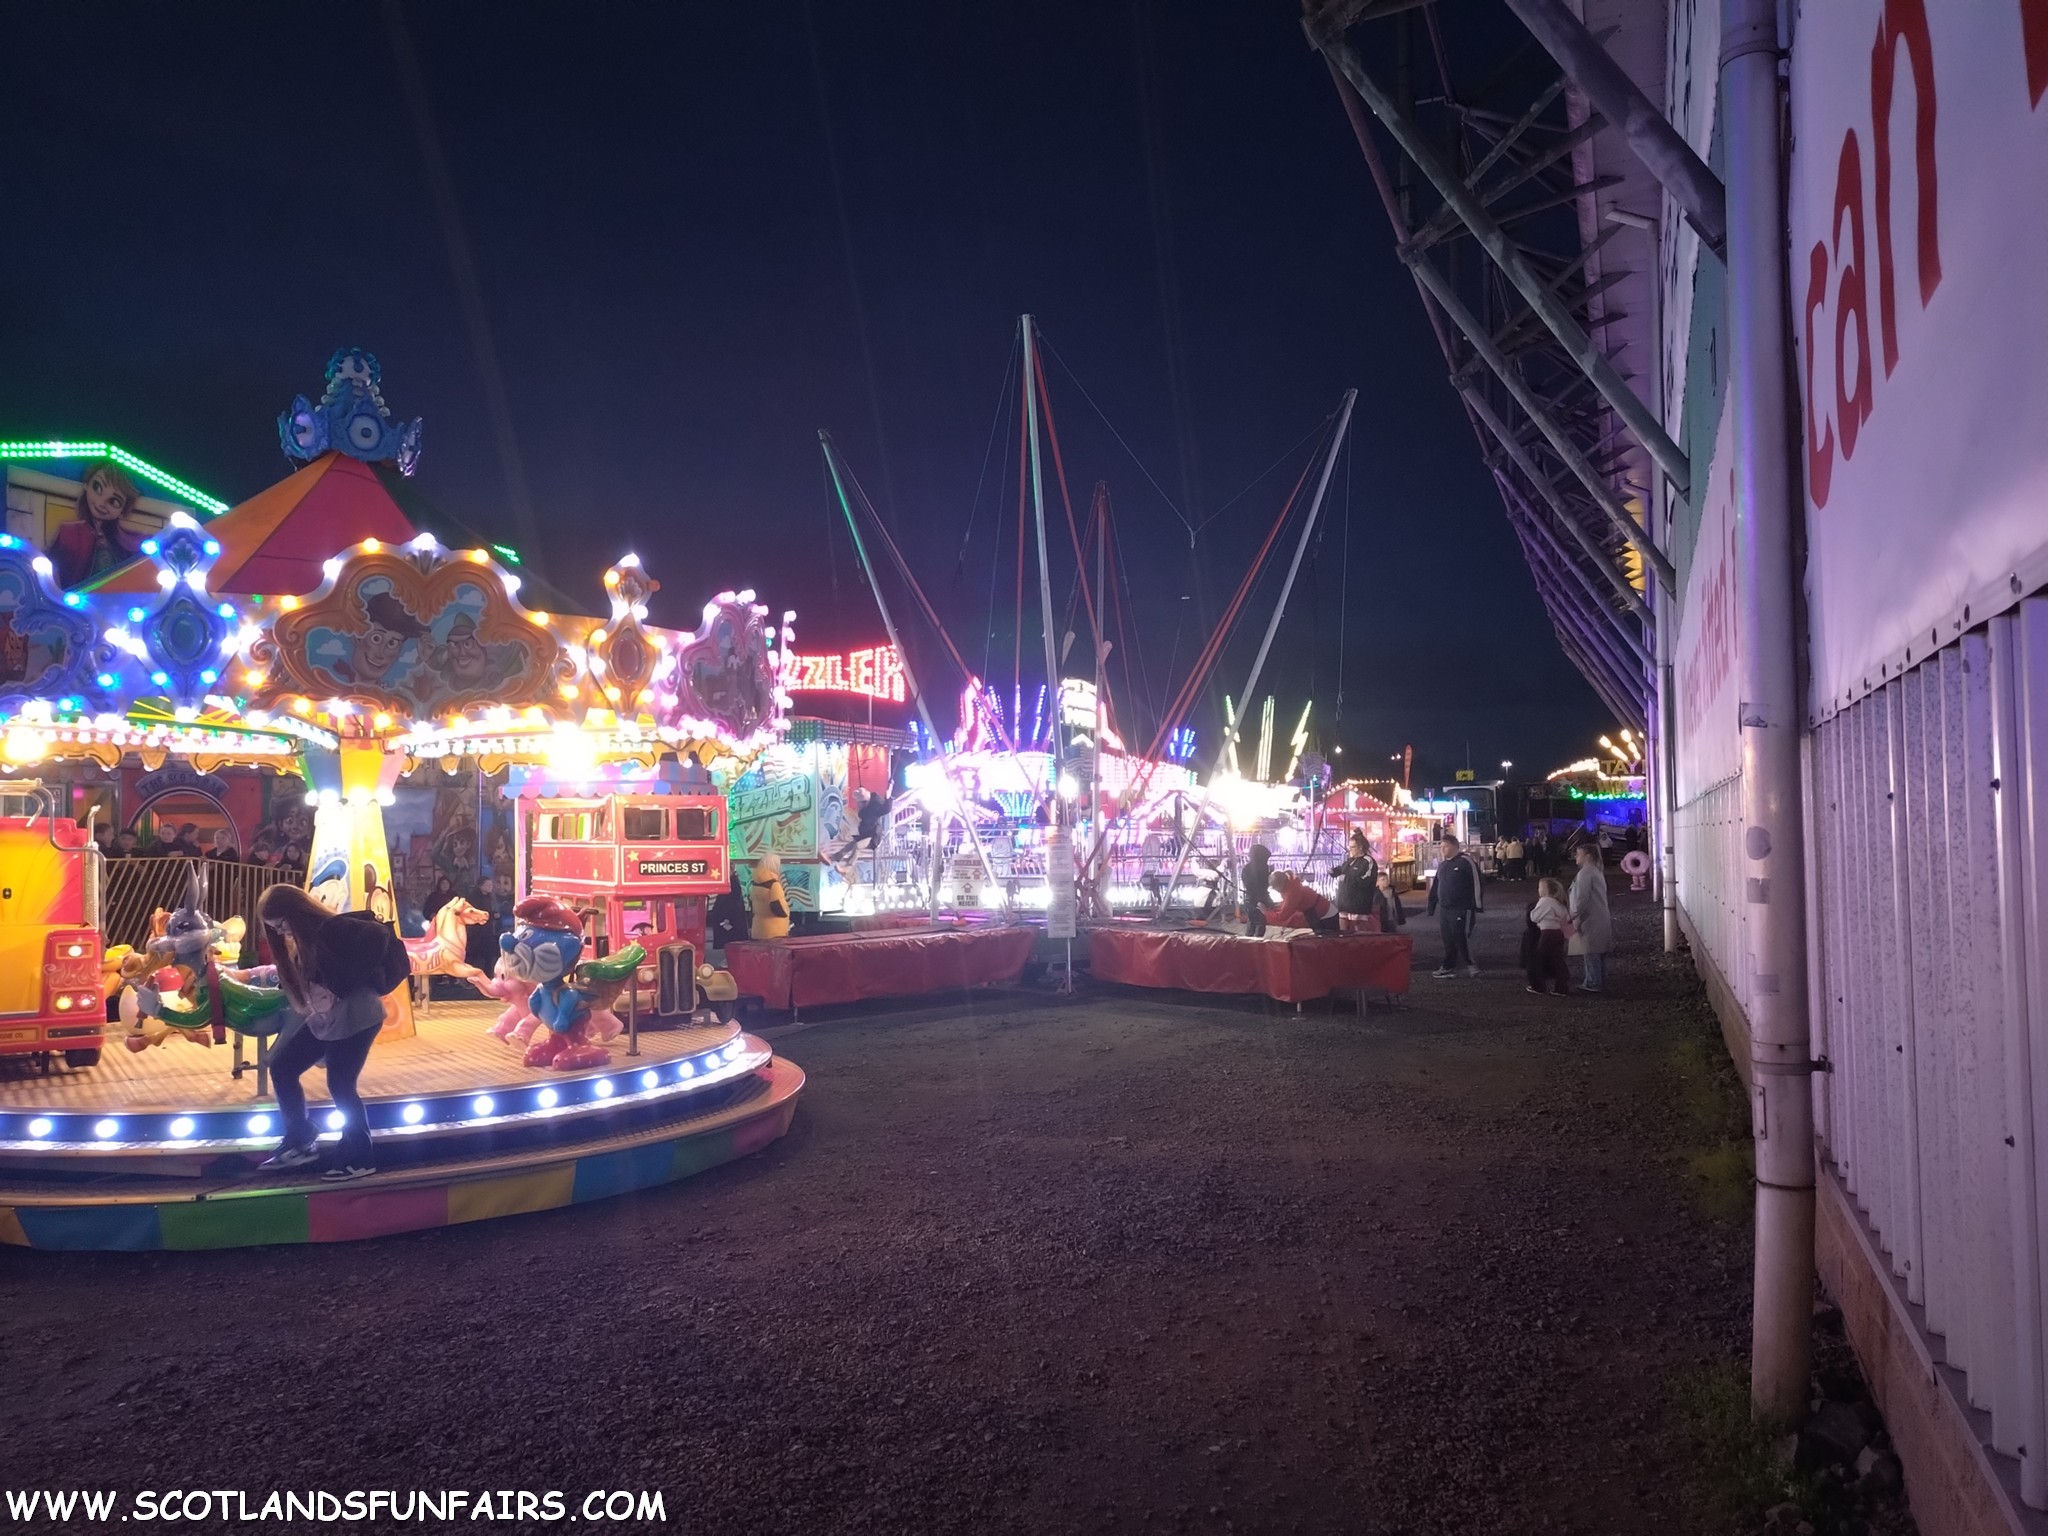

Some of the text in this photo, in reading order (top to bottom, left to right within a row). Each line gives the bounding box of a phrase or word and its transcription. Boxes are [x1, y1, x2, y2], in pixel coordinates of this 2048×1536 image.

[1806, 0, 1942, 510] can
[784, 645, 904, 702] ZZLER
[734, 777, 809, 820] IZZLER
[640, 863, 705, 874] PRINCES ST
